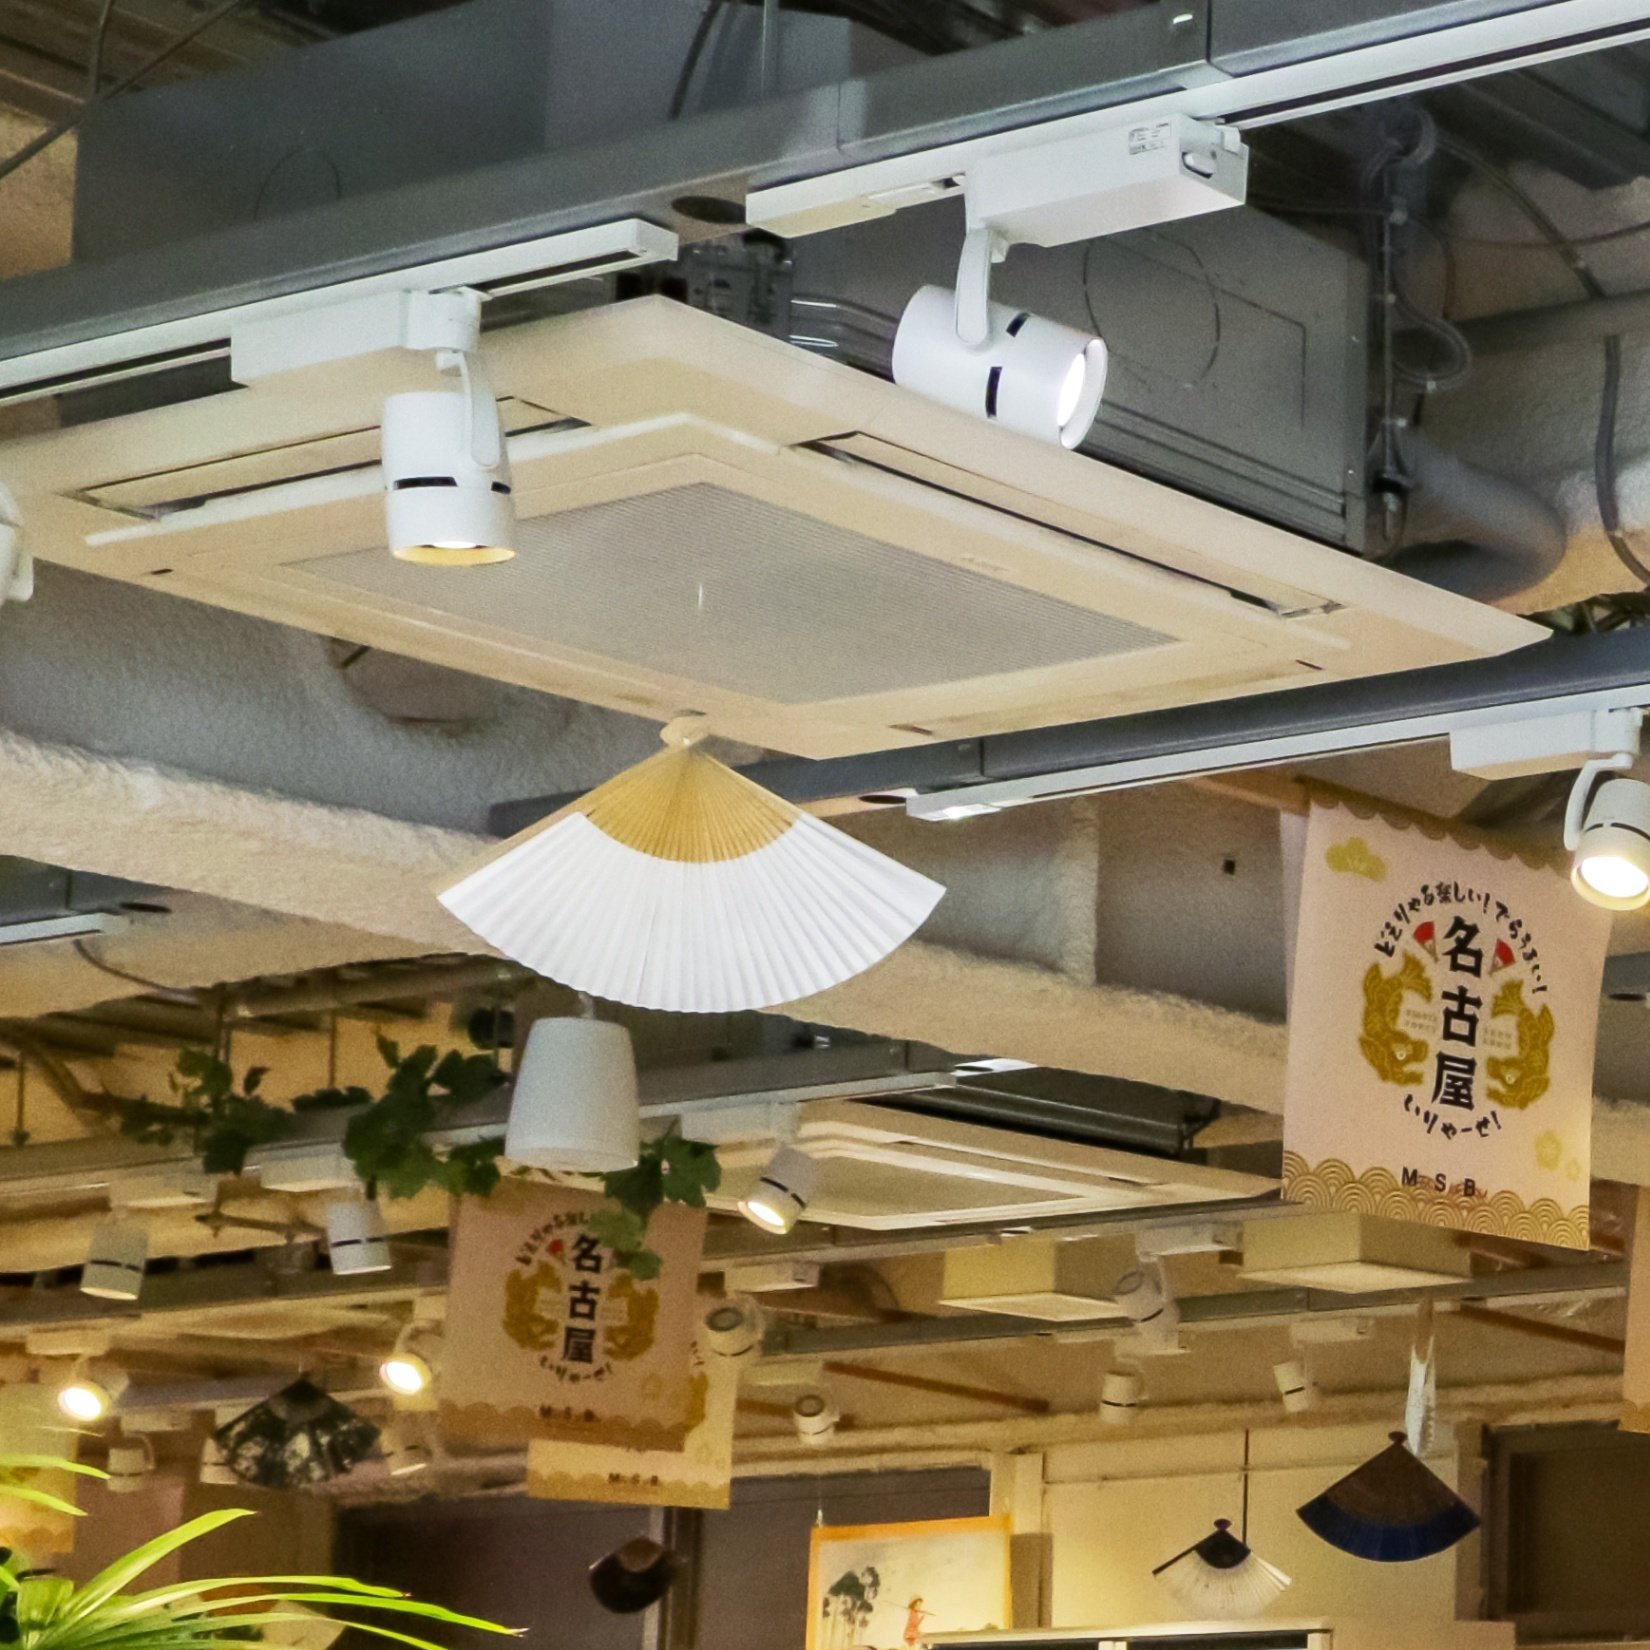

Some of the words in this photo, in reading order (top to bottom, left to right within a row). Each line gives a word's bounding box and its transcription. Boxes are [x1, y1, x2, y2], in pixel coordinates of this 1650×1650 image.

[1431, 915, 1484, 1112] 名古屋
[564, 1234, 601, 1363] 名古屋
